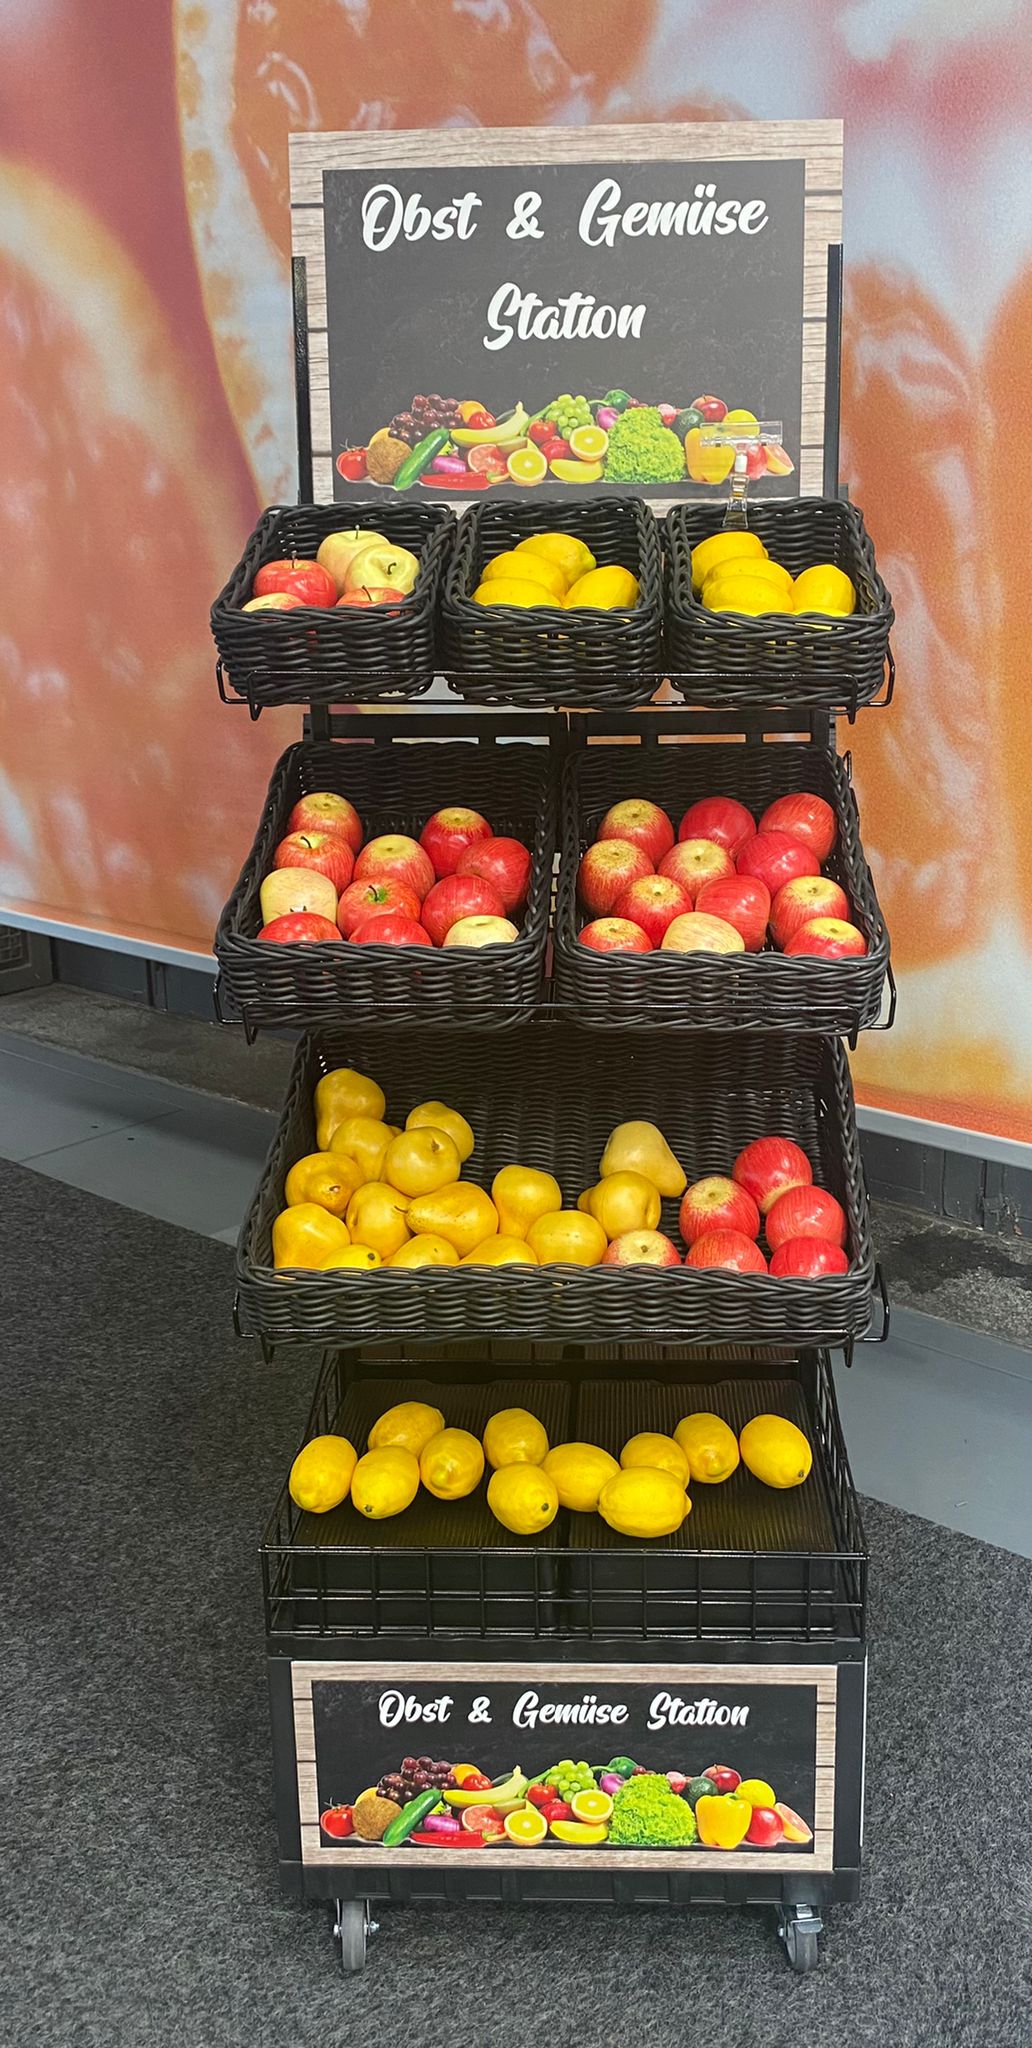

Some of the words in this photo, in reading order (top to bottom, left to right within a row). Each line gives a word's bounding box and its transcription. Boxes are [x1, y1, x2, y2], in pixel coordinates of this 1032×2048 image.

[361, 183, 483, 252] Obst
[505, 190, 545, 240] &
[578, 177, 770, 248] Gemüse
[482, 282, 648, 351] Station
[377, 1689, 454, 1728] Obst
[467, 1696, 493, 1723] &
[512, 1690, 630, 1729] Gemüse
[646, 1691, 751, 1731] Station
